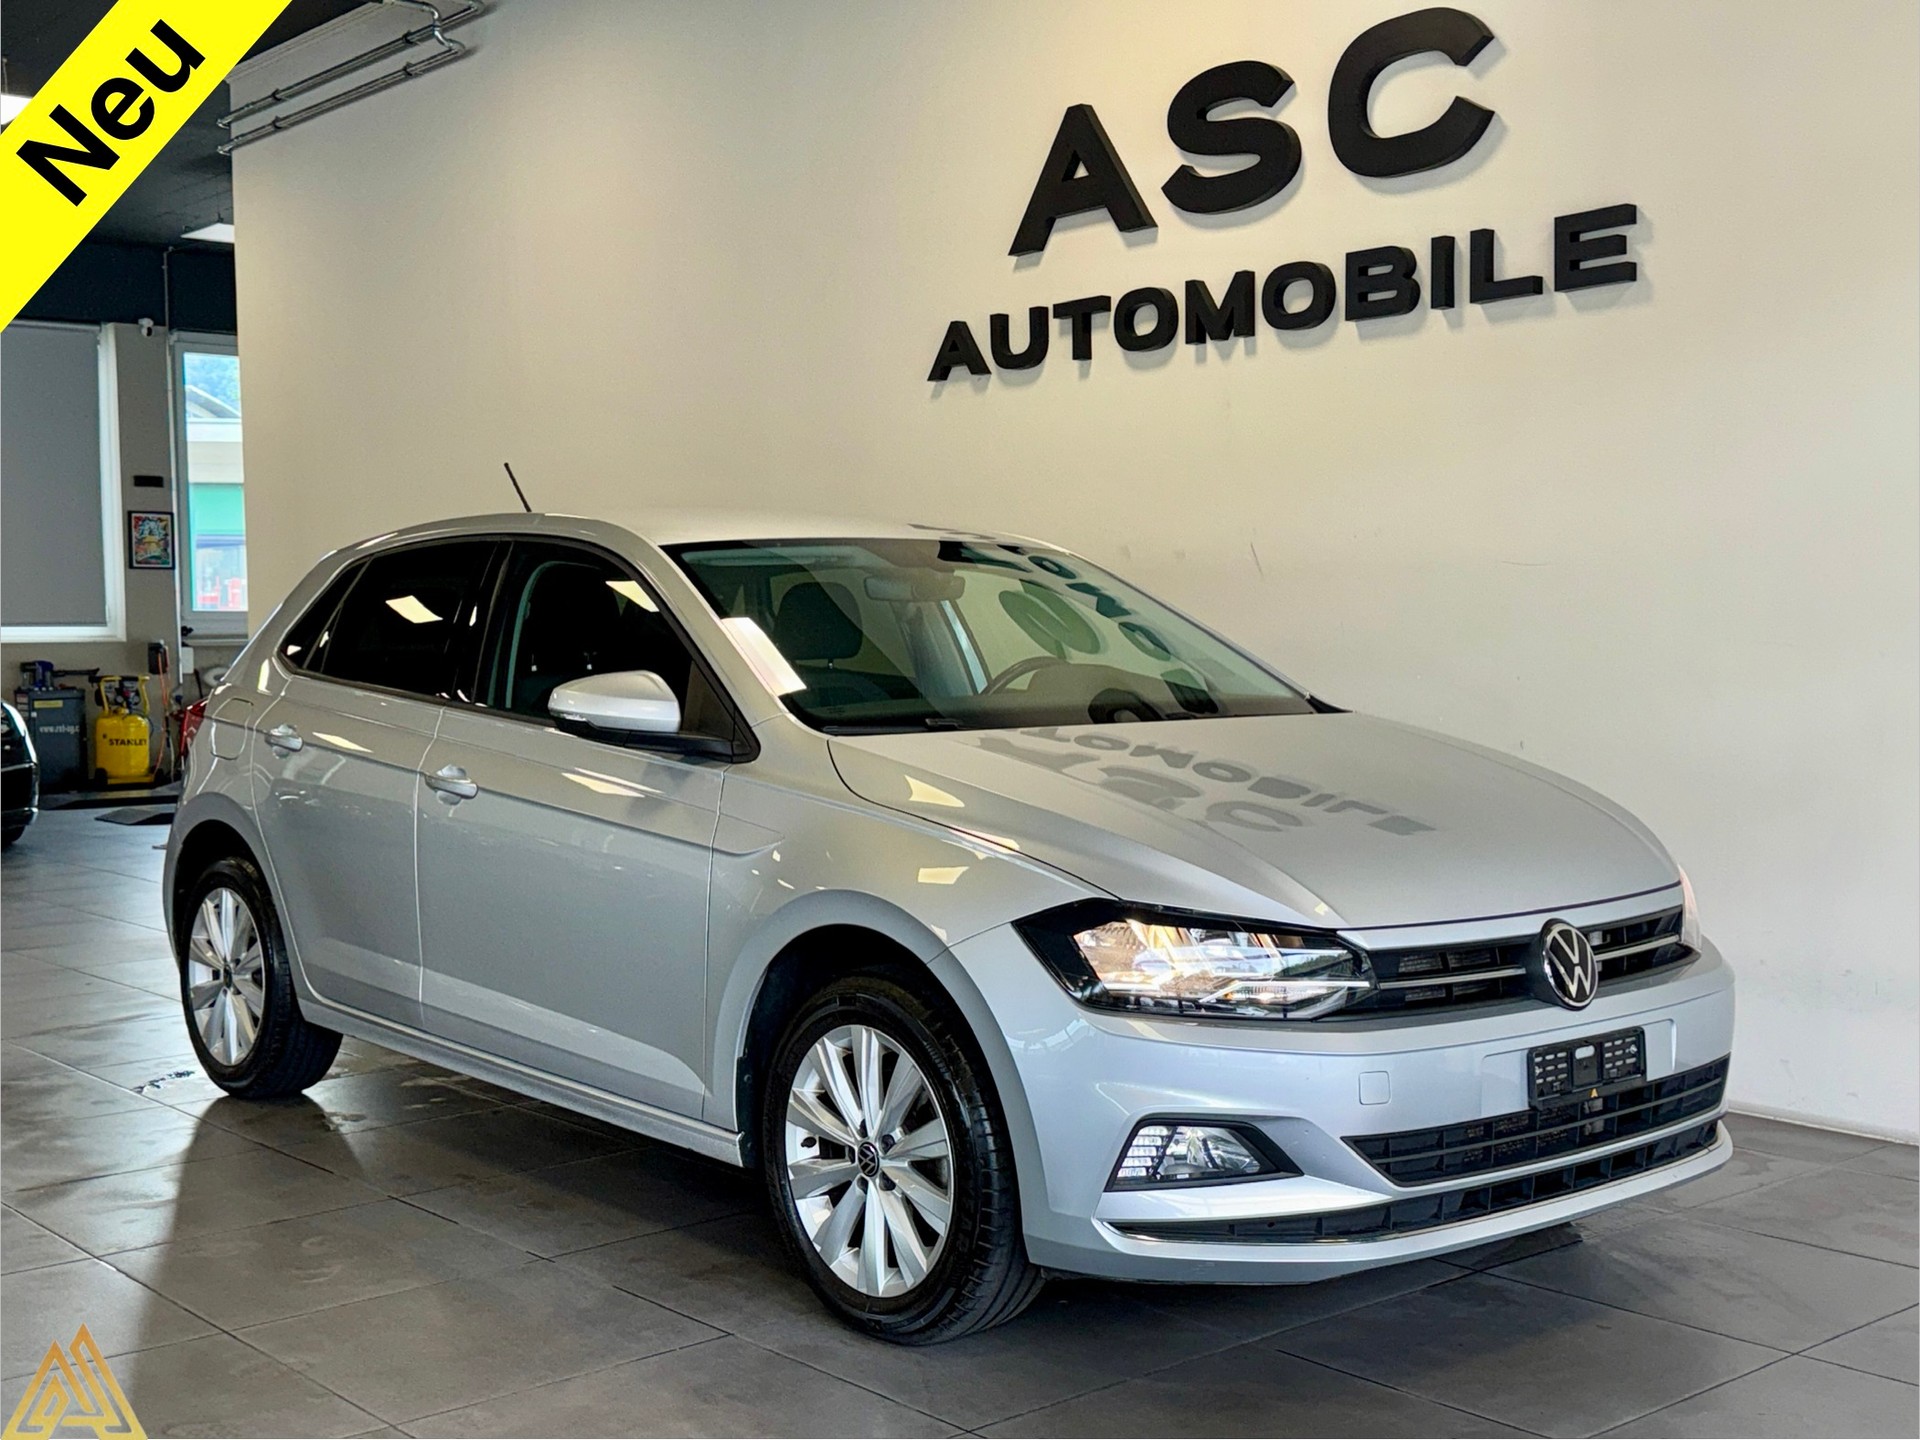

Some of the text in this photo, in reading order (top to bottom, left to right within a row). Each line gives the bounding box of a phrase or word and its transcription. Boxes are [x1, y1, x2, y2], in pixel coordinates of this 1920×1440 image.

[1008, 7, 1495, 257] ASC
[927, 203, 1638, 382] AUTOMOBILE
[109, 738, 148, 747] STANLEY
